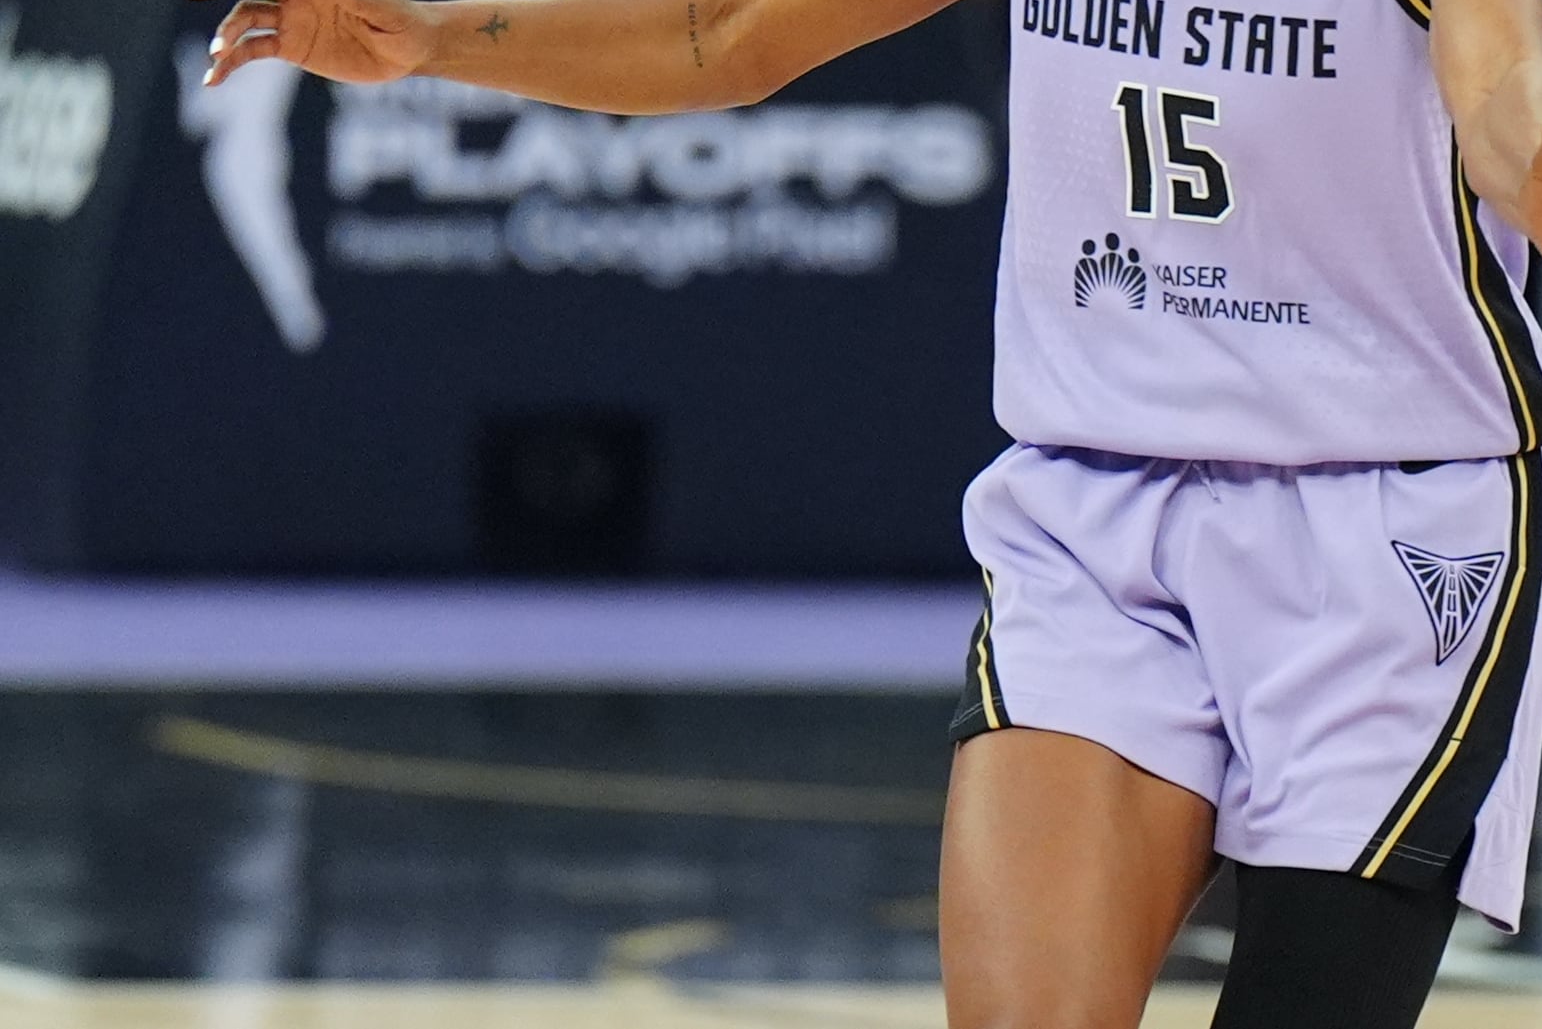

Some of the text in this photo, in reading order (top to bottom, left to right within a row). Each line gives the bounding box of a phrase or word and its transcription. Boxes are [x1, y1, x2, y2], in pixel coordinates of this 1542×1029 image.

[1183, 6, 1339, 79] STATE
[1110, 81, 1236, 224] 15
[1162, 290, 1312, 325] PERMANENTE
